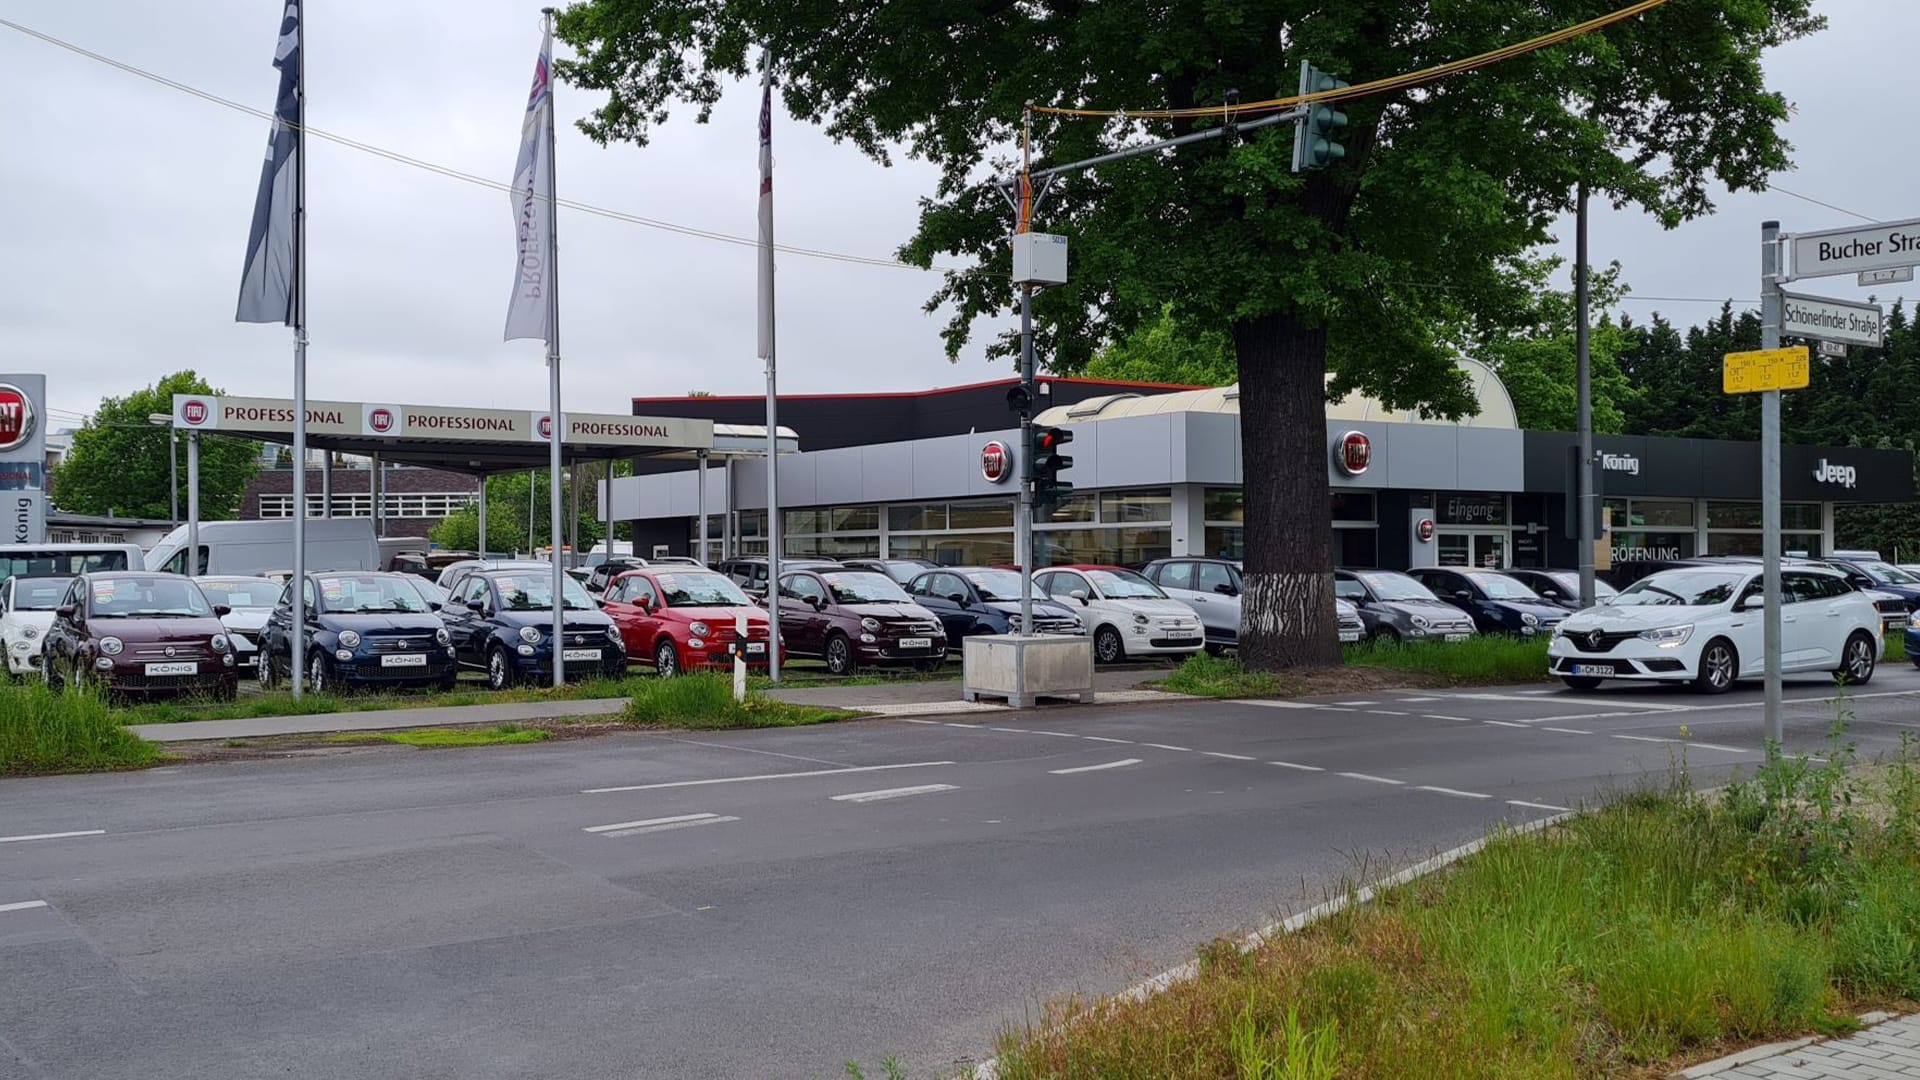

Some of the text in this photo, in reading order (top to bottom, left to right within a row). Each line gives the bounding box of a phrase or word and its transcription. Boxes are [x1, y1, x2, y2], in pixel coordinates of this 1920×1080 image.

[1819, 238, 1883, 262] Bucher
[1784, 303, 1878, 338] Schönerlinder Straße
[187, 405, 203, 418] FIAT
[224, 407, 345, 424] PROFESSONAL
[374, 413, 389, 426] FIAT
[408, 415, 515, 432] PROFESSIONAL
[572, 422, 669, 438] PROFESSIONAL
[1603, 453, 1639, 475] König
[1815, 458, 1856, 488] Jeep
[15, 498, 32, 543] König
[1448, 500, 1495, 521] Eingang
